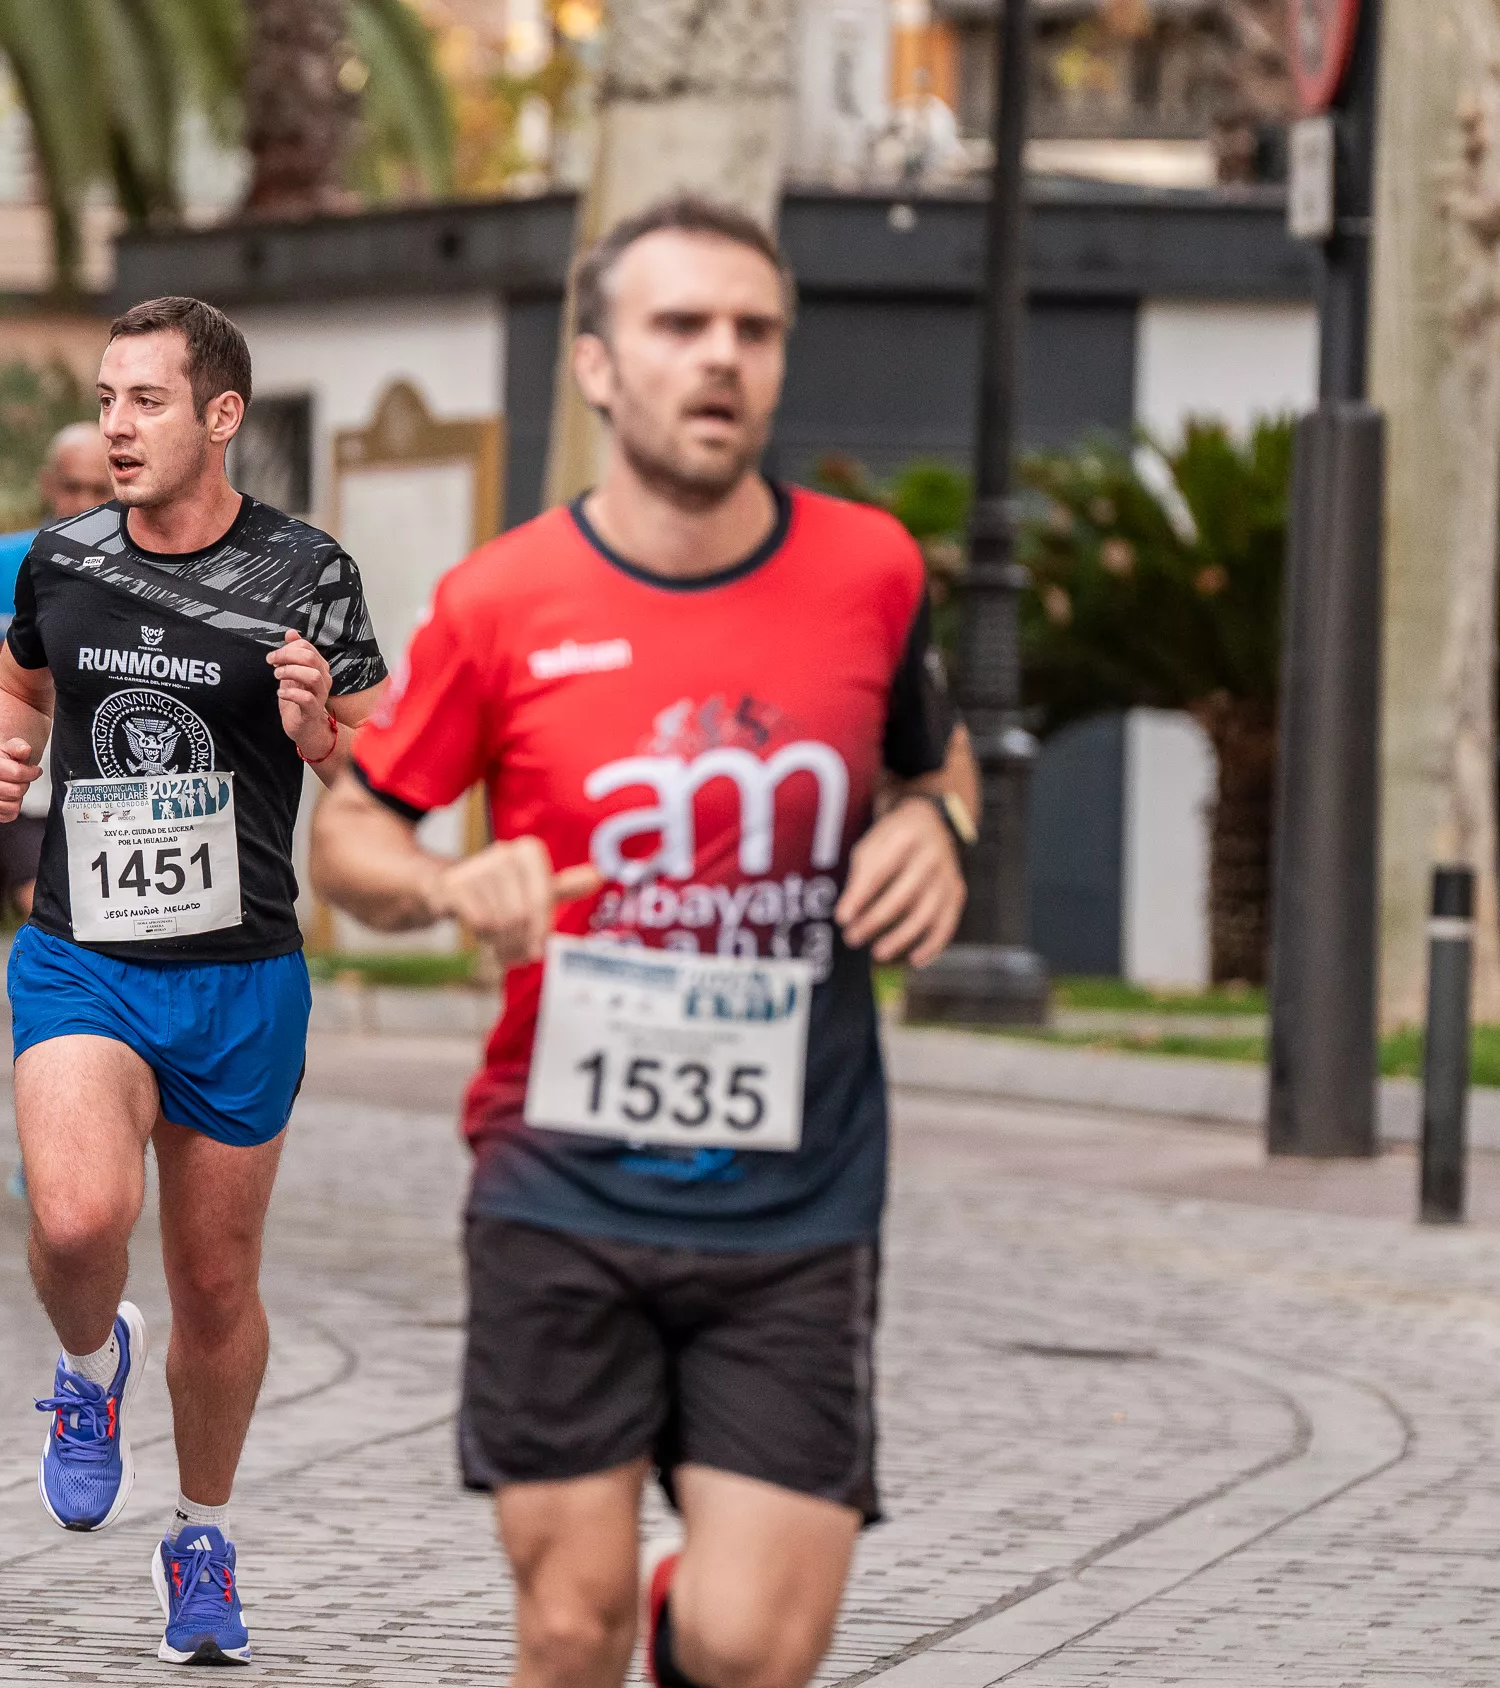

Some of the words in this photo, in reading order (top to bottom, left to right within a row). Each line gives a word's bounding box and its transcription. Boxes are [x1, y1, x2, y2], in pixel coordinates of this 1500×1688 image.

[140, 625, 165, 638] Rock
[78, 647, 221, 686] RUNMONES
[96, 692, 172, 754] NIGHTRUNNING
[174, 706, 209, 770] CORDOBA
[68, 793, 101, 802] CARRERAS
[103, 791, 148, 801] POPULARES
[94, 784, 136, 794] PROVINCIAL
[139, 783, 147, 791] DE
[149, 780, 196, 799] 2024
[584, 740, 849, 880] am
[118, 828, 130, 836] C.P.
[167, 825, 194, 833] LUCENA
[144, 836, 178, 844] IGUALDAD
[92, 842, 212, 898] 1451
[104, 909, 128, 919] JESUS
[130, 906, 160, 918] MUÑOZ
[164, 902, 200, 914] MELLADO
[575, 1049, 765, 1131] 1535
